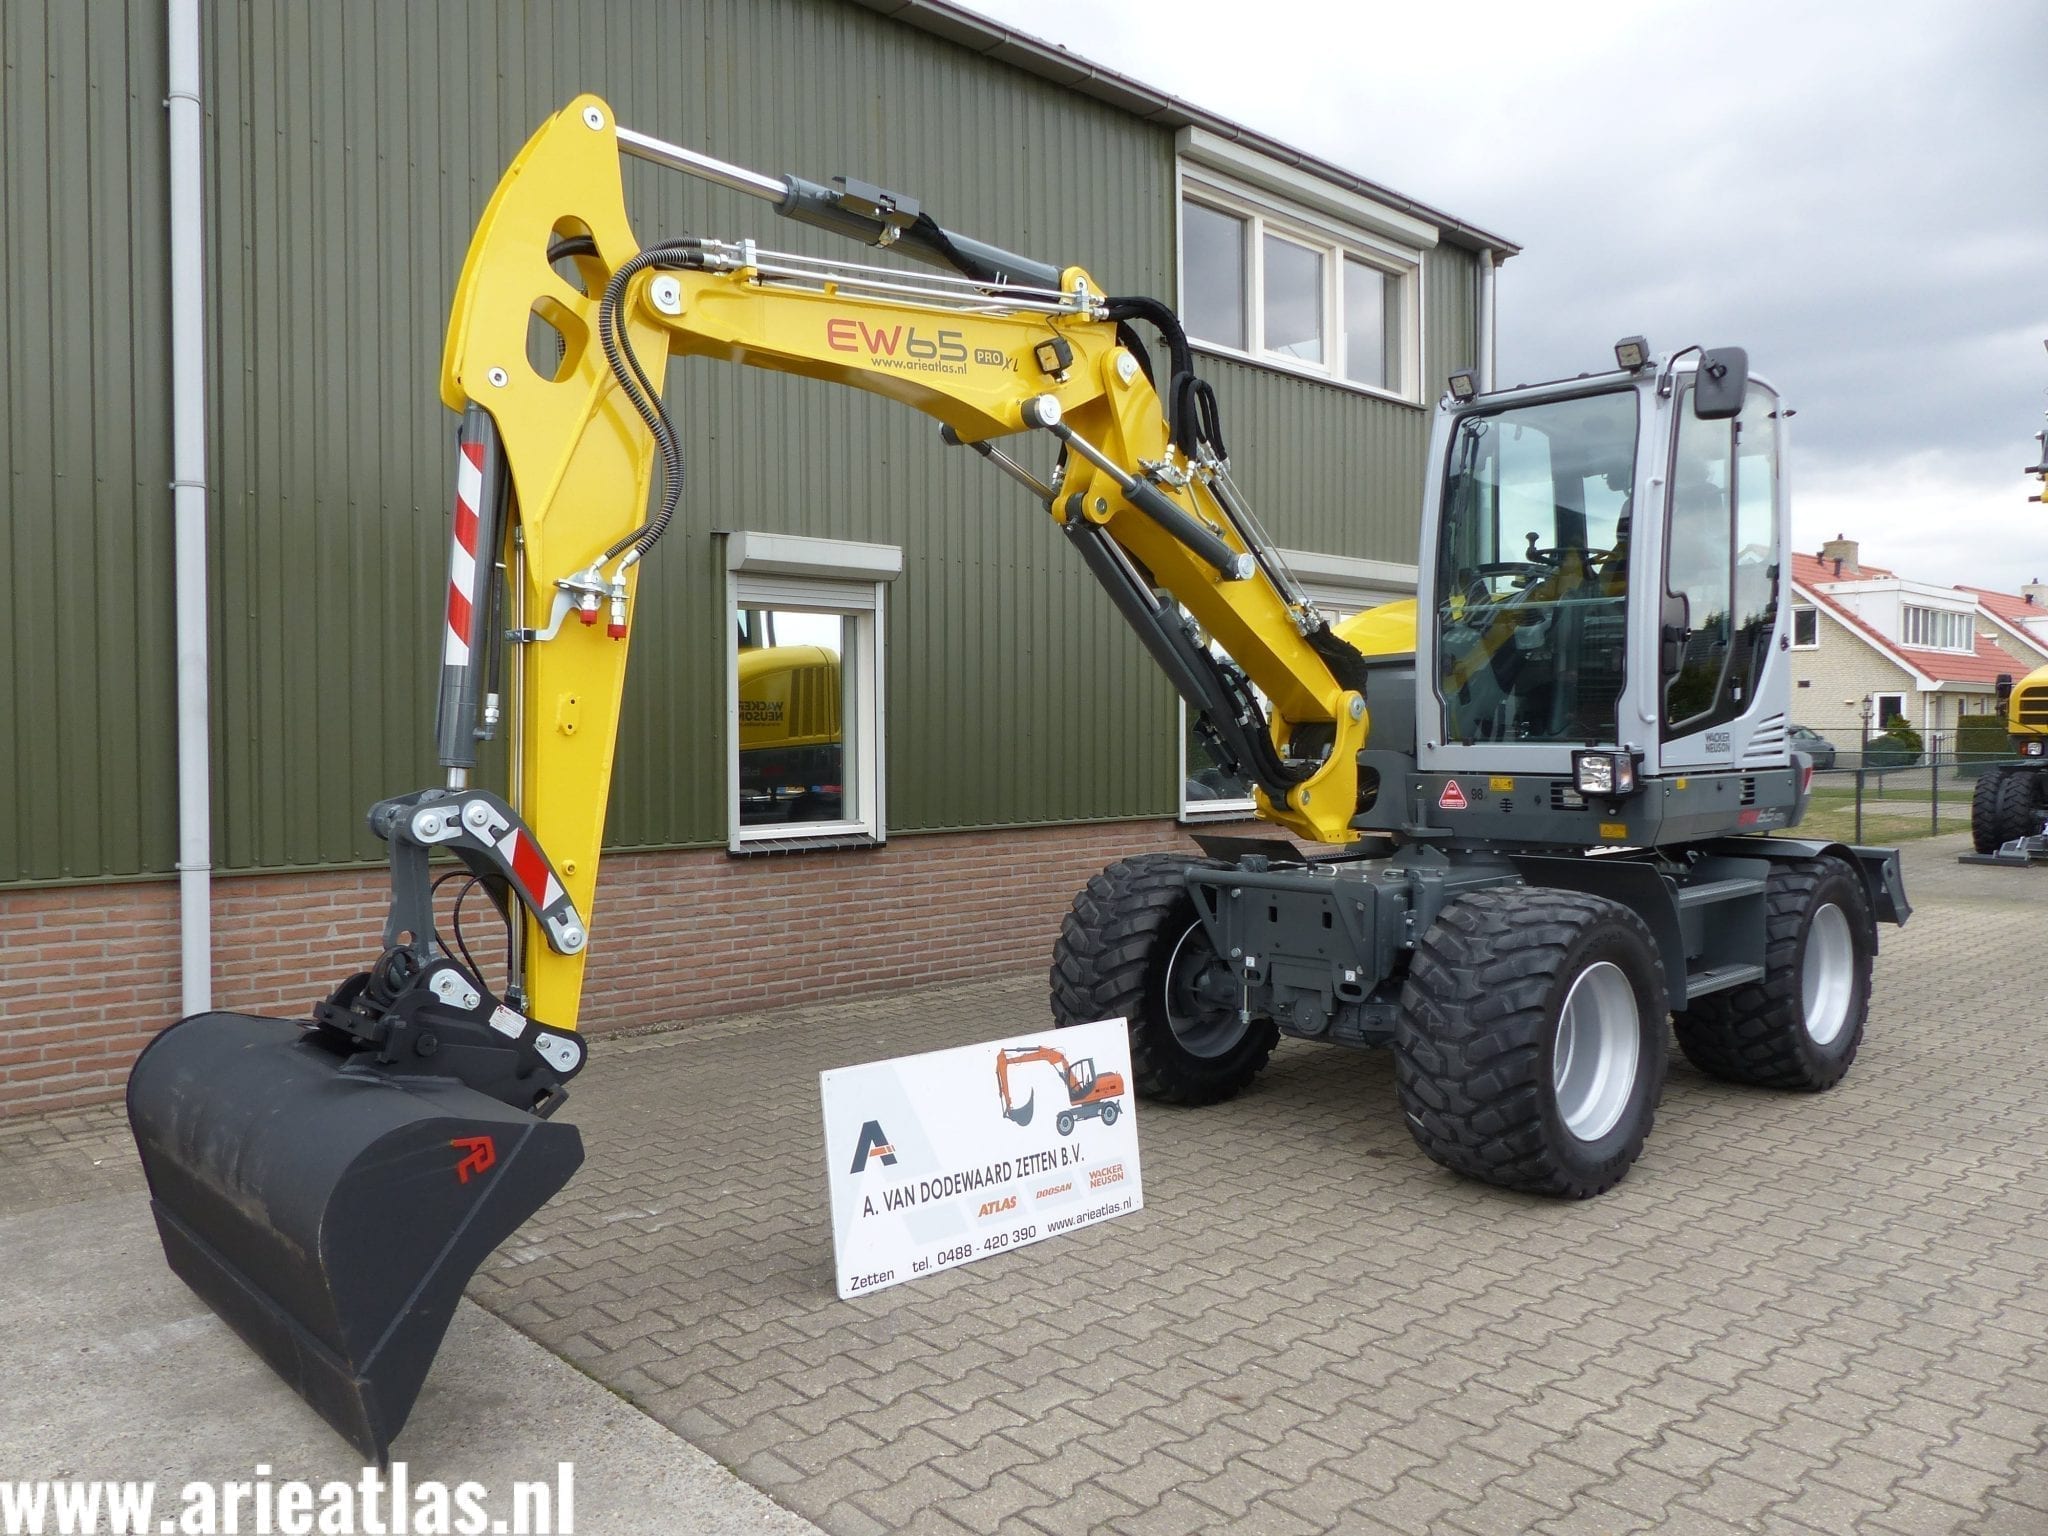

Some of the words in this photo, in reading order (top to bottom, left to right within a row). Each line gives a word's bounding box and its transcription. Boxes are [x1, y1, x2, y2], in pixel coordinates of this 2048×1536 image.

[827, 318, 968, 362] EW65
[977, 350, 1001, 364] PRO
[870, 357, 967, 375] www.arieatlas.nl
[1704, 732, 1730, 742] WACKER
[1705, 743, 1731, 753] NEUSON
[863, 1195, 879, 1218] A.
[883, 1184, 916, 1212] VAN
[920, 1161, 1012, 1203] DODEWAARD
[1015, 1149, 1058, 1178] ZETTEN
[1061, 1143, 1085, 1166] B.V.
[1088, 1163, 1123, 1180] WACKER
[1090, 1172, 1124, 1189] NEUSON
[1035, 1182, 1072, 1200] DOOSAN
[977, 1195, 1017, 1218] ATLAS
[850, 1269, 895, 1291] Zetten
[912, 1256, 933, 1273] tel.
[937, 1244, 972, 1265] 0488
[983, 1233, 1009, 1251] 420
[1012, 1225, 1037, 1243] 390
[1047, 1195, 1132, 1233] www.arieatlas.nl
